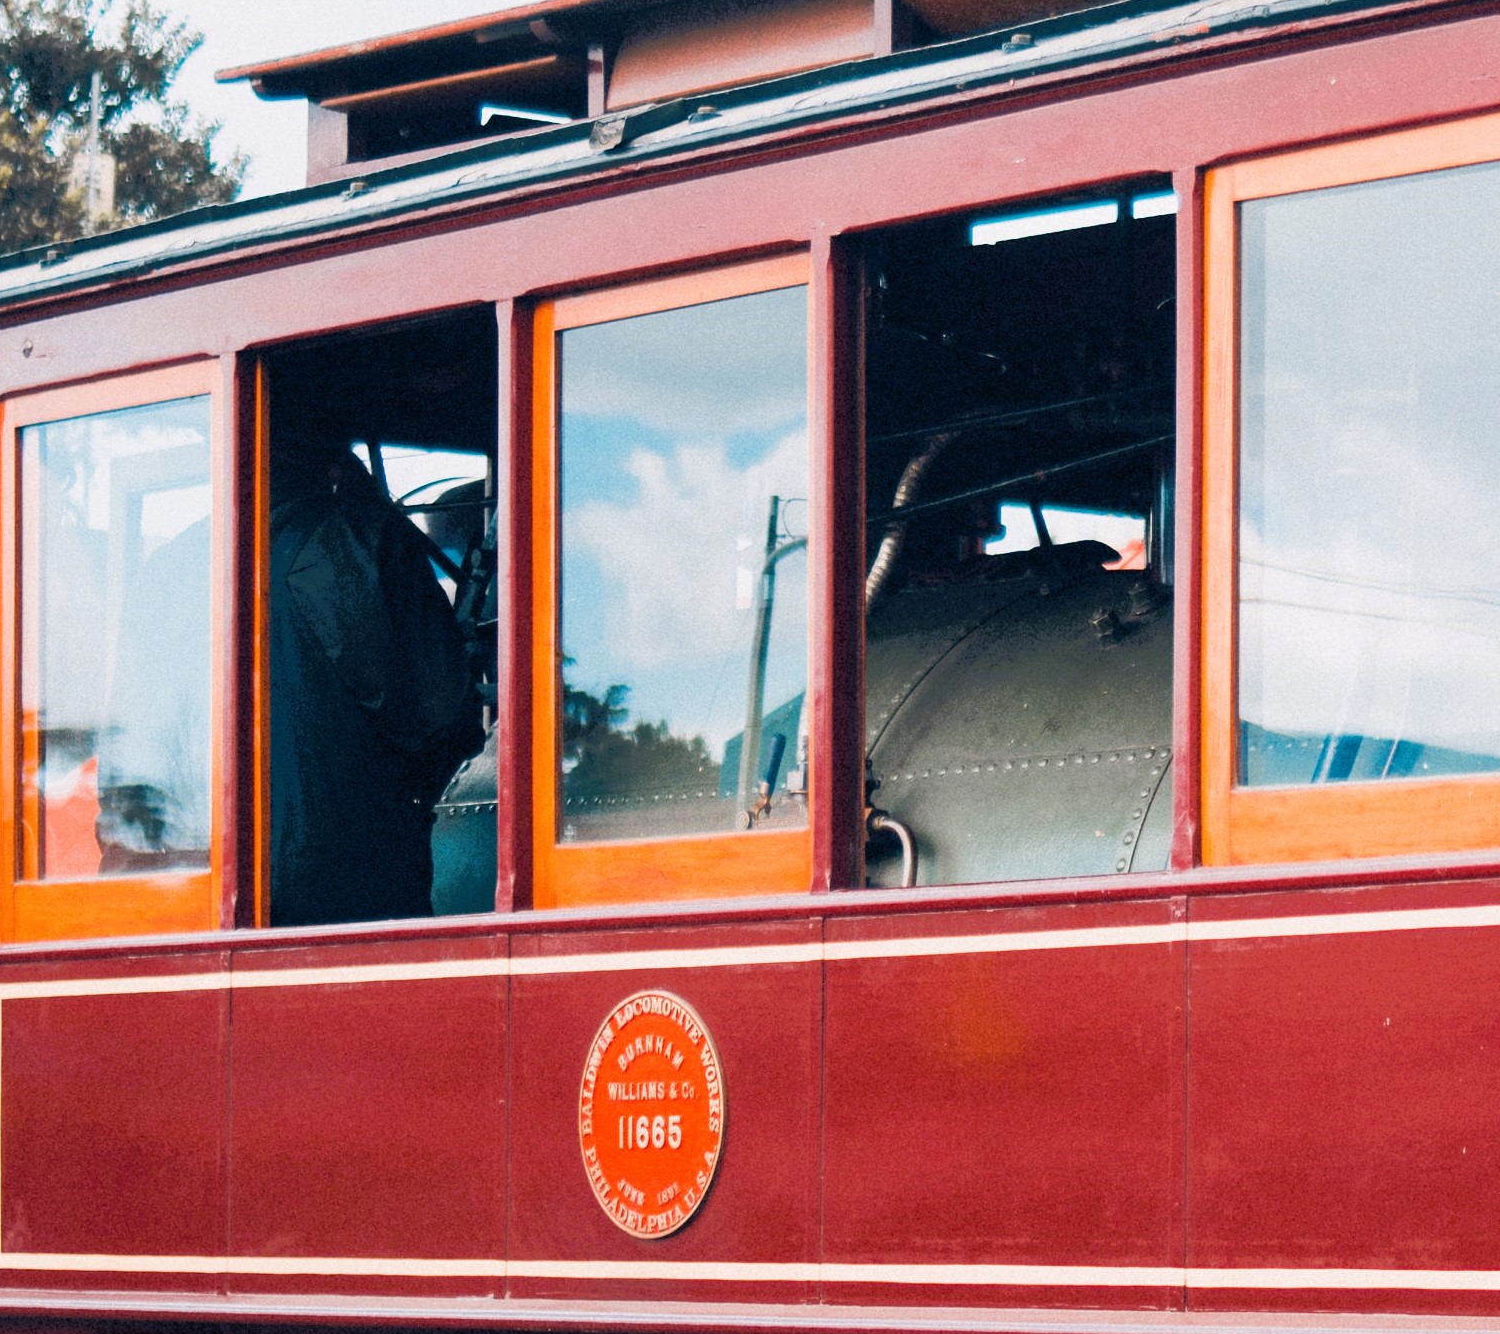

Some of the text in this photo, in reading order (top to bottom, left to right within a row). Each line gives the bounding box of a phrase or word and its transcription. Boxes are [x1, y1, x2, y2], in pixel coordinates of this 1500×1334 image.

[613, 996, 703, 1045] LOCOMOTIVE
[700, 1043, 721, 1134] WORKS
[617, 1034, 685, 1071] BURNHAM
[608, 1082, 665, 1101] WILLIAMS
[669, 1082, 678, 1100] &
[618, 1115, 682, 1150] 11665
[585, 1145, 684, 1234] PHILADELPHIA
